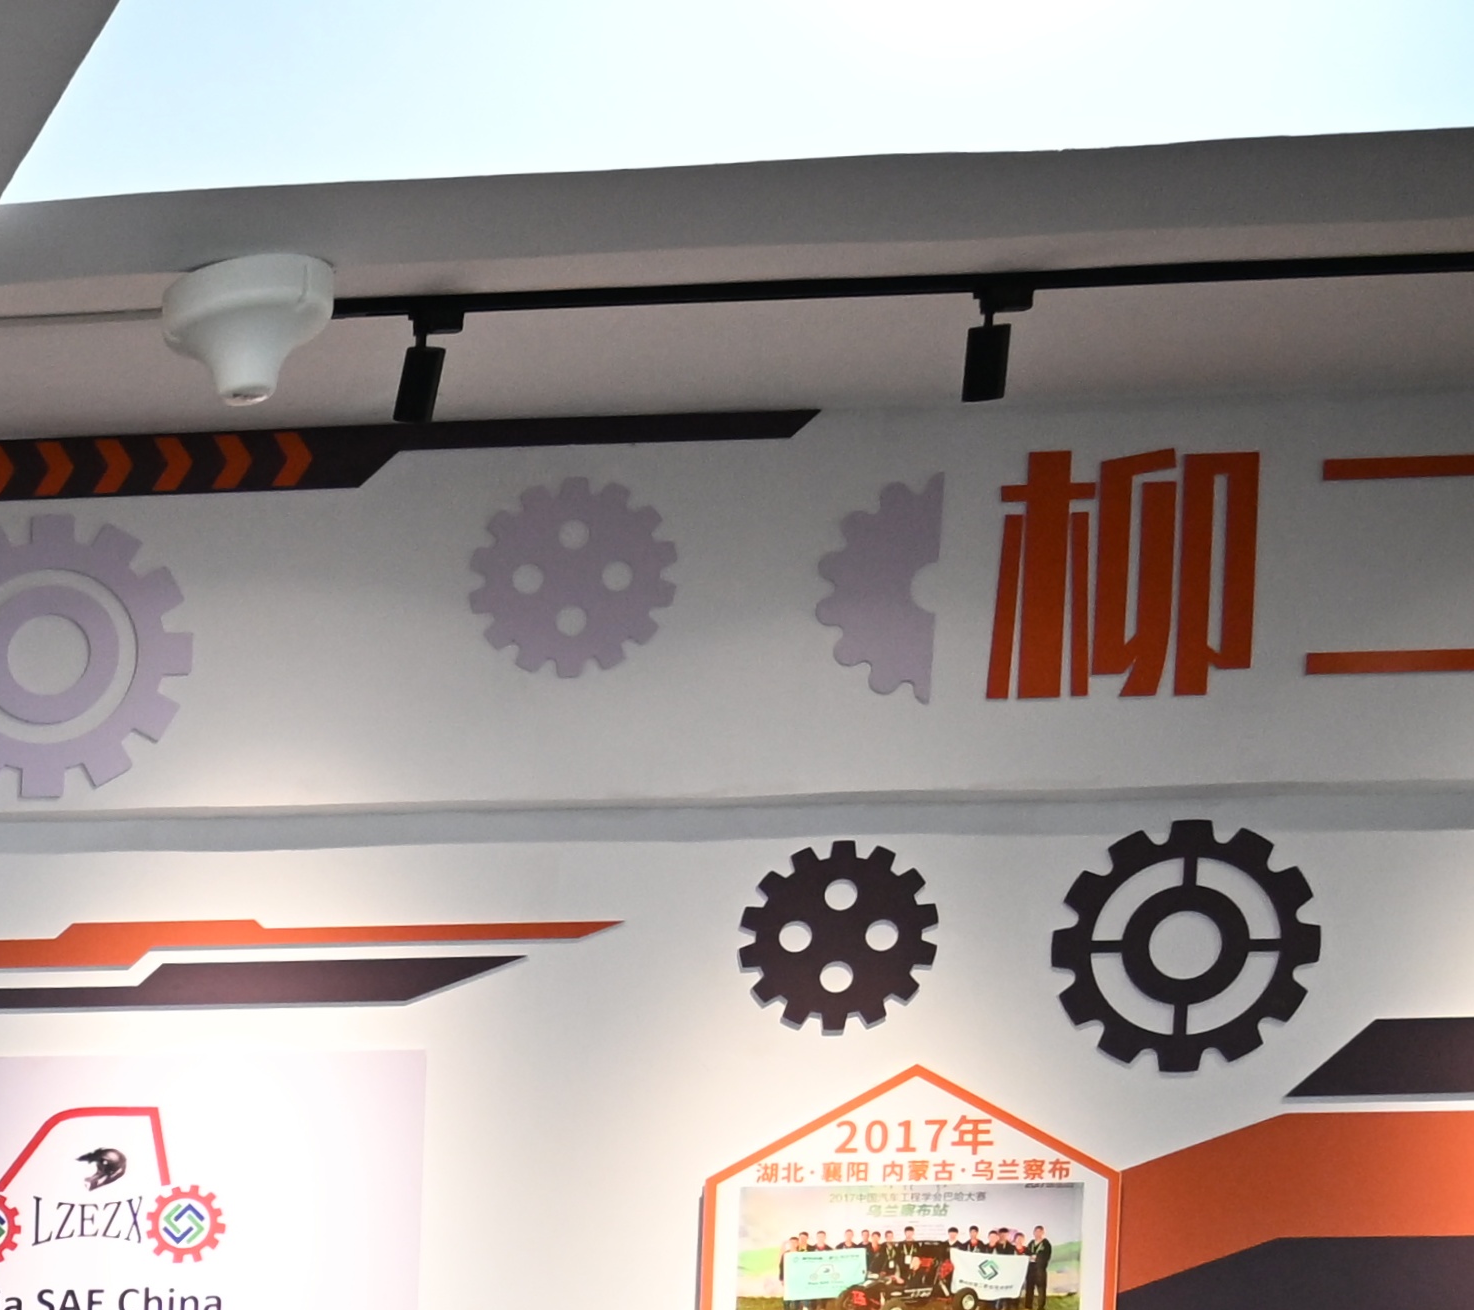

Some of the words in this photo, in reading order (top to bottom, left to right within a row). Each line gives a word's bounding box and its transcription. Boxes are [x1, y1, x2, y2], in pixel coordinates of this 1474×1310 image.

[834, 1115, 995, 1155] 2017年
[756, 1161, 869, 1184] 湖北·襄阳
[882, 1158, 1072, 1183] 内蒙古·乌兰察布
[31, 1195, 143, 1247] LZEZX
